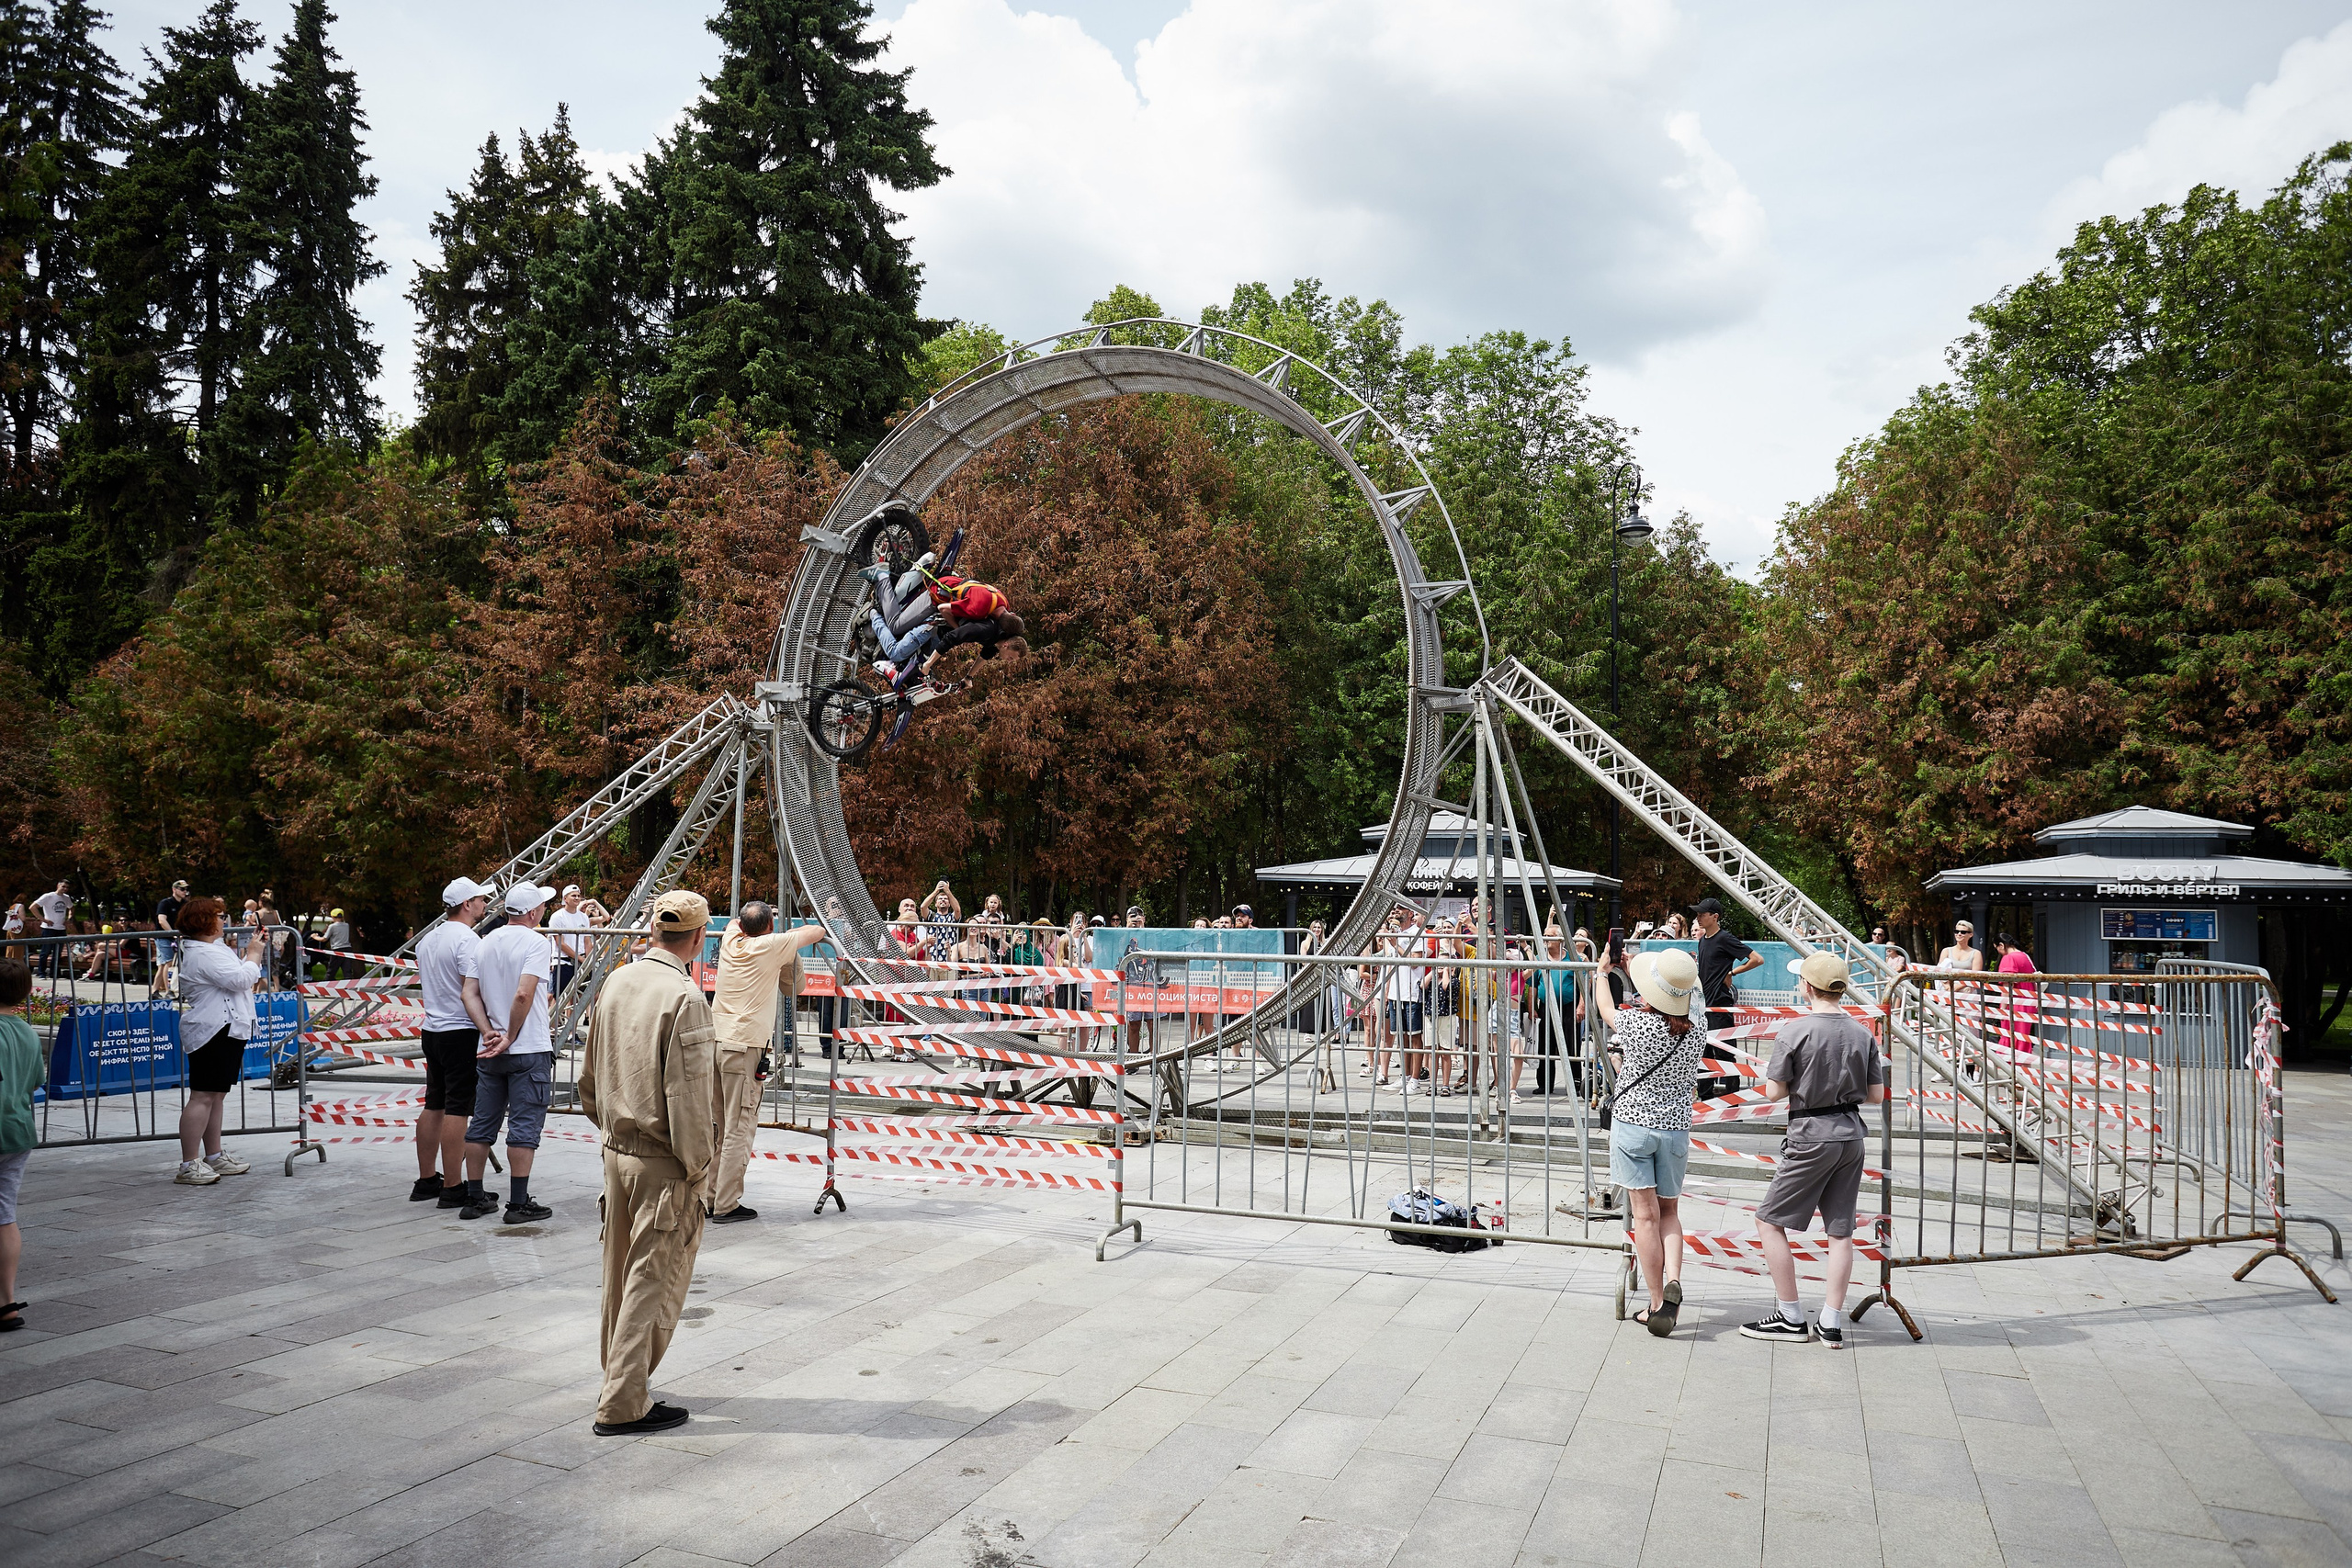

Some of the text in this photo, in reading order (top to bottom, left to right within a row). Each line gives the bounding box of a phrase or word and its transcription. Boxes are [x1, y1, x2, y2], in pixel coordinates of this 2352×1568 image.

[2097, 884, 2153, 896] ГРИЛЬ
[2155, 884, 2168, 896] И
[702, 971, 718, 983] Ден
[1103, 988, 1218, 1002] Дь мооциклиста
[119, 1043, 173, 1055] ТРАНСПОТНОЙ
[100, 1054, 164, 1066] ИНФРАСРУКТРЫ
